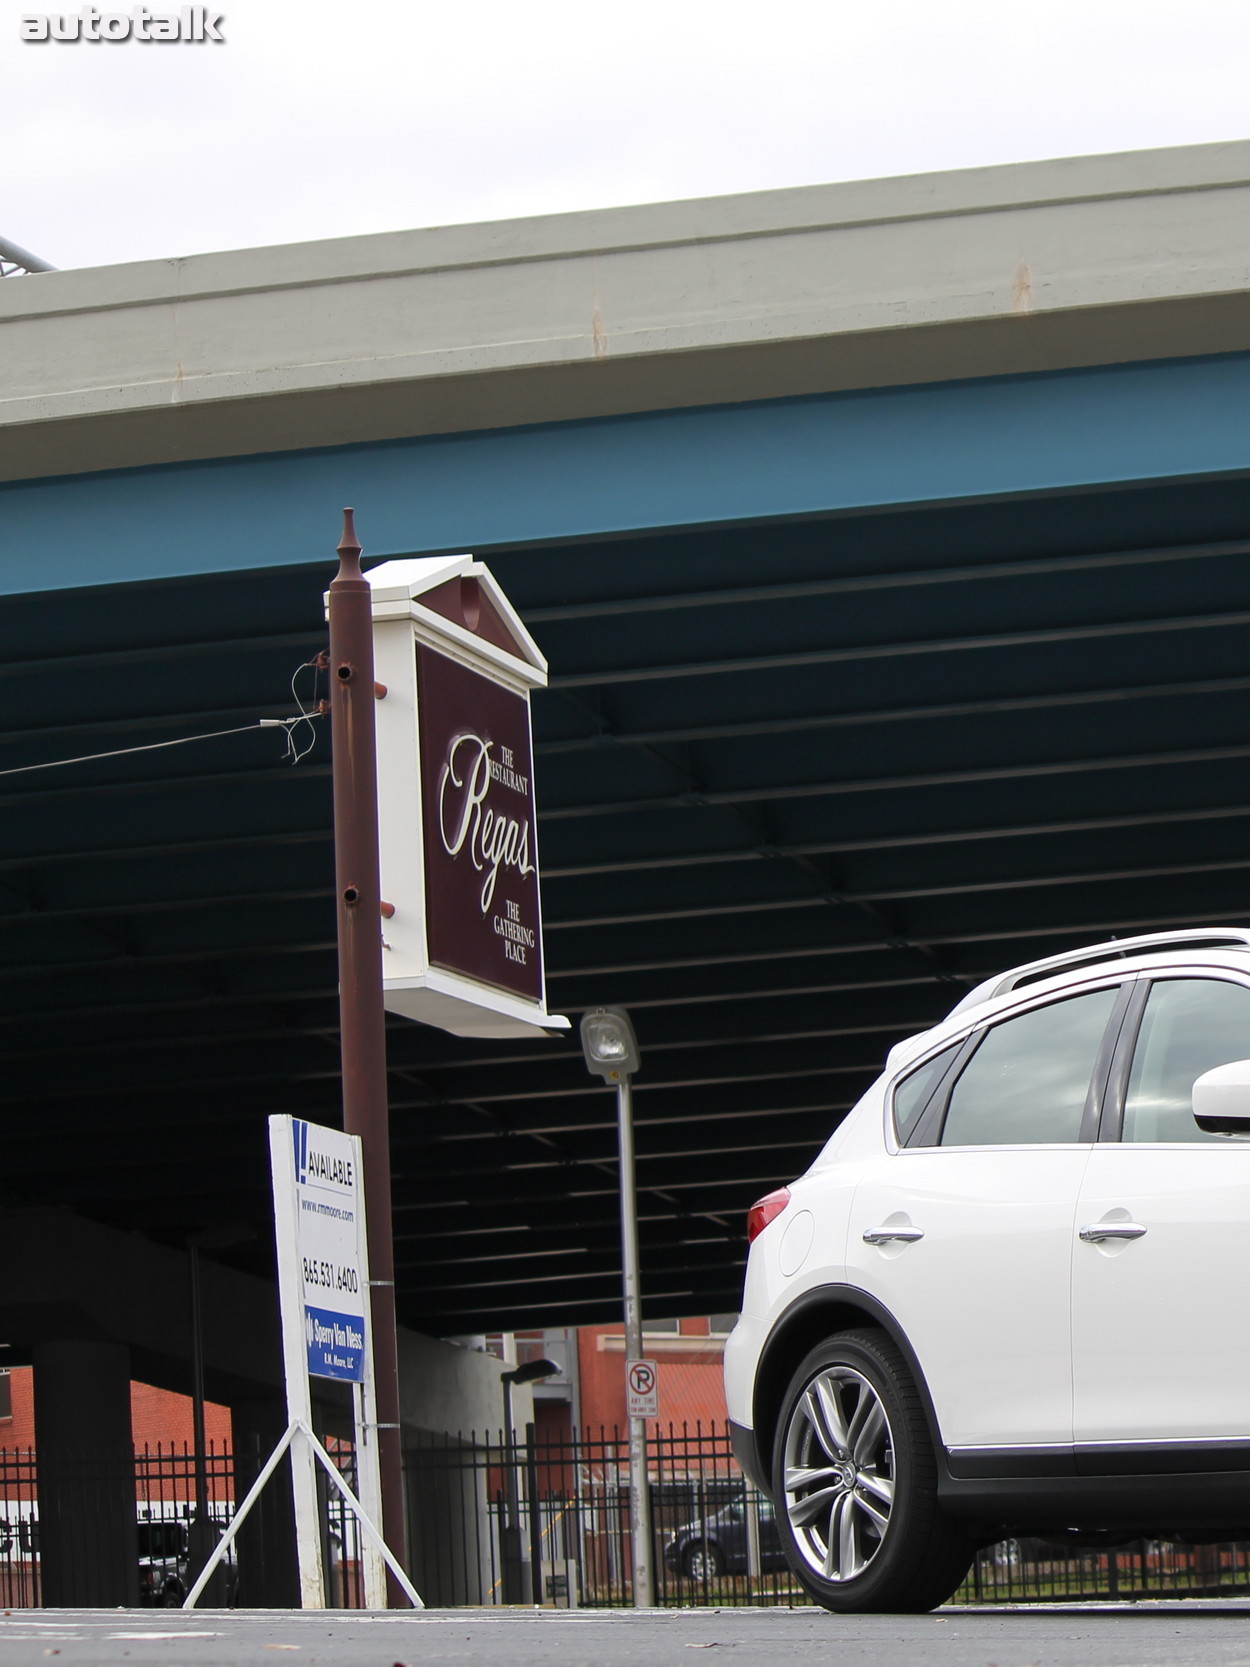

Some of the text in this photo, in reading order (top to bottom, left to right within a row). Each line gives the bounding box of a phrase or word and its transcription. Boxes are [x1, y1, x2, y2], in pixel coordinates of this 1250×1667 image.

[501, 745, 514, 769] THE
[489, 758, 528, 796] RESTAURANT
[439, 733, 536, 914] Regas
[505, 899, 520, 923] THE
[493, 915, 535, 948] GATHERING
[504, 940, 527, 965] PLACE
[308, 1150, 353, 1187] AVAILABLE
[301, 1199, 354, 1222] www.rmmoore.com
[303, 1257, 358, 1294] 865.531.6400
[314, 1318, 334, 1350] Sperry
[333, 1322, 346, 1347] Van
